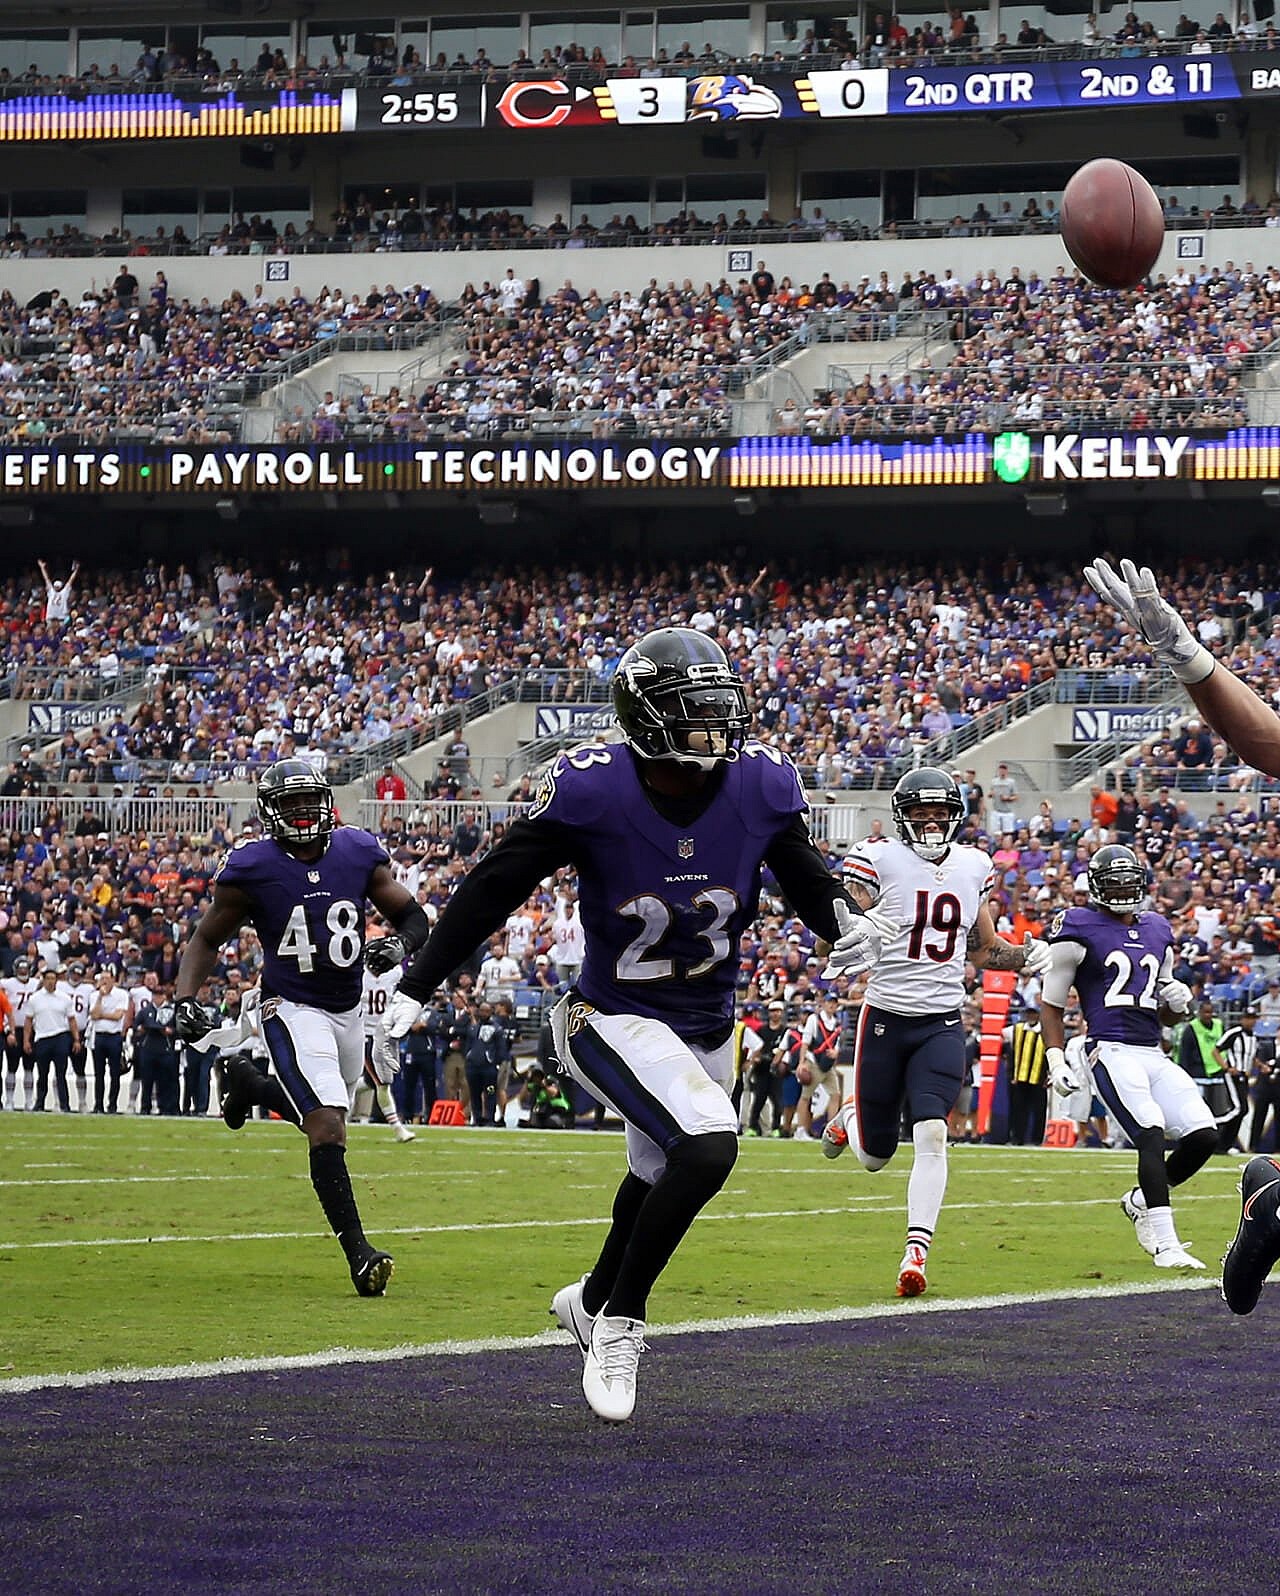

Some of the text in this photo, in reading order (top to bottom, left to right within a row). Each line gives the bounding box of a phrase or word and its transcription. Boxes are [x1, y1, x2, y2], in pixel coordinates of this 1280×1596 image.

[905, 72, 1034, 106] 2ND QTR
[1080, 63, 1212, 98] 2ND & 11
[638, 87, 659, 117] 3
[842, 79, 865, 110] 0
[381, 93, 458, 124] 2:55
[5, 454, 120, 485] EFITS
[172, 452, 363, 484] PAYROLL
[415, 447, 720, 483] TECHNOLOGY
[1041, 434, 1191, 479] KELLY
[1088, 652, 1104, 668] 55
[766, 697, 781, 712] 40
[293, 717, 310, 735] 51
[415, 840, 429, 854] 23
[1146, 837, 1163, 853] 22
[664, 874, 709, 883] RAVENS
[1258, 868, 1276, 885] 34
[277, 902, 362, 973] 48
[511, 925, 524, 938] 54
[561, 929, 576, 944] 34
[615, 887, 741, 982] 23
[907, 890, 962, 963] 19
[758, 973, 778, 997] 34
[1102, 949, 1159, 1009] 22
[16, 992, 33, 1010] 7
[433, 1104, 456, 1125] 30
[1046, 1123, 1070, 1145] 20
